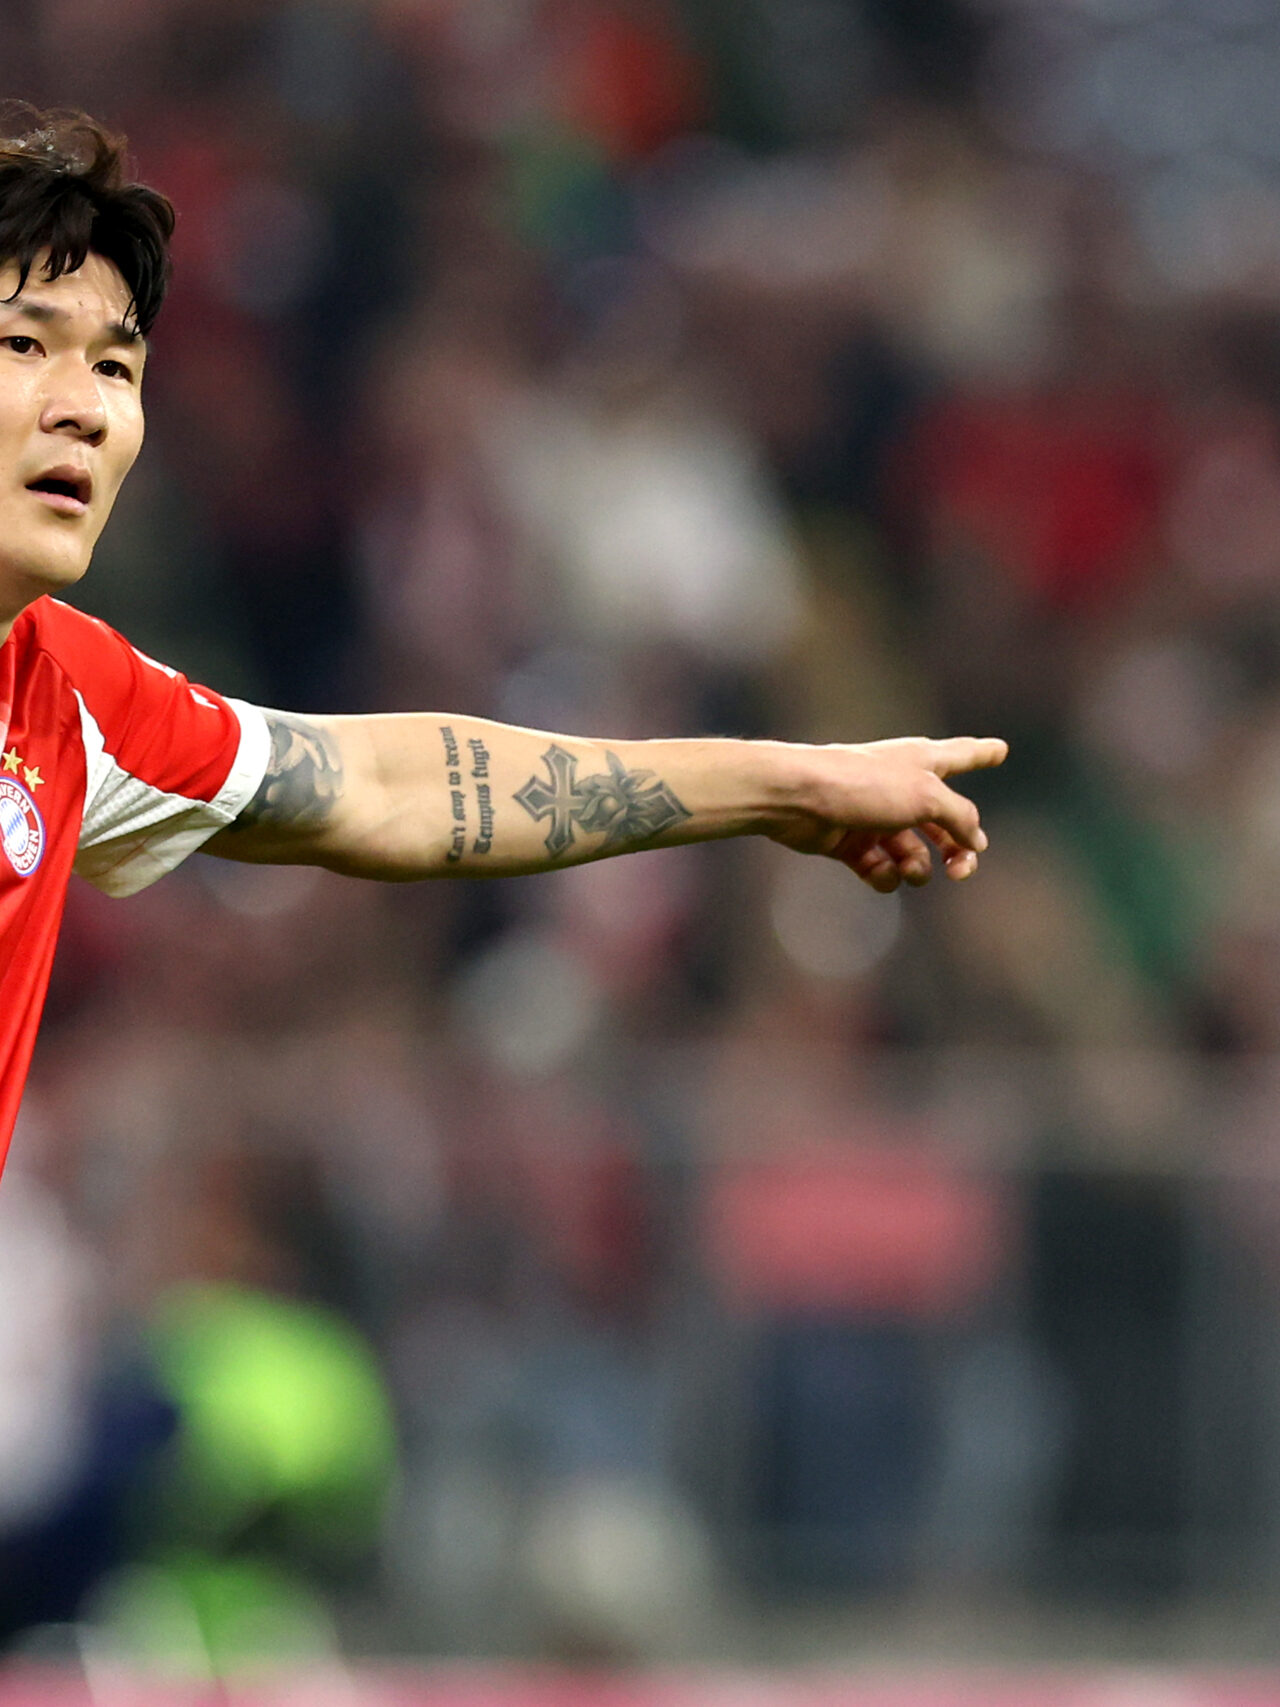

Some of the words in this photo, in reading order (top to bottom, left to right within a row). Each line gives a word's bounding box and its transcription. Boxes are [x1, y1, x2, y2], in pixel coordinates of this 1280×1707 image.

[439, 726, 460, 767] dream
[467, 738, 490, 778] fugit
[449, 771, 461, 785] to
[473, 784, 495, 854] Tempus
